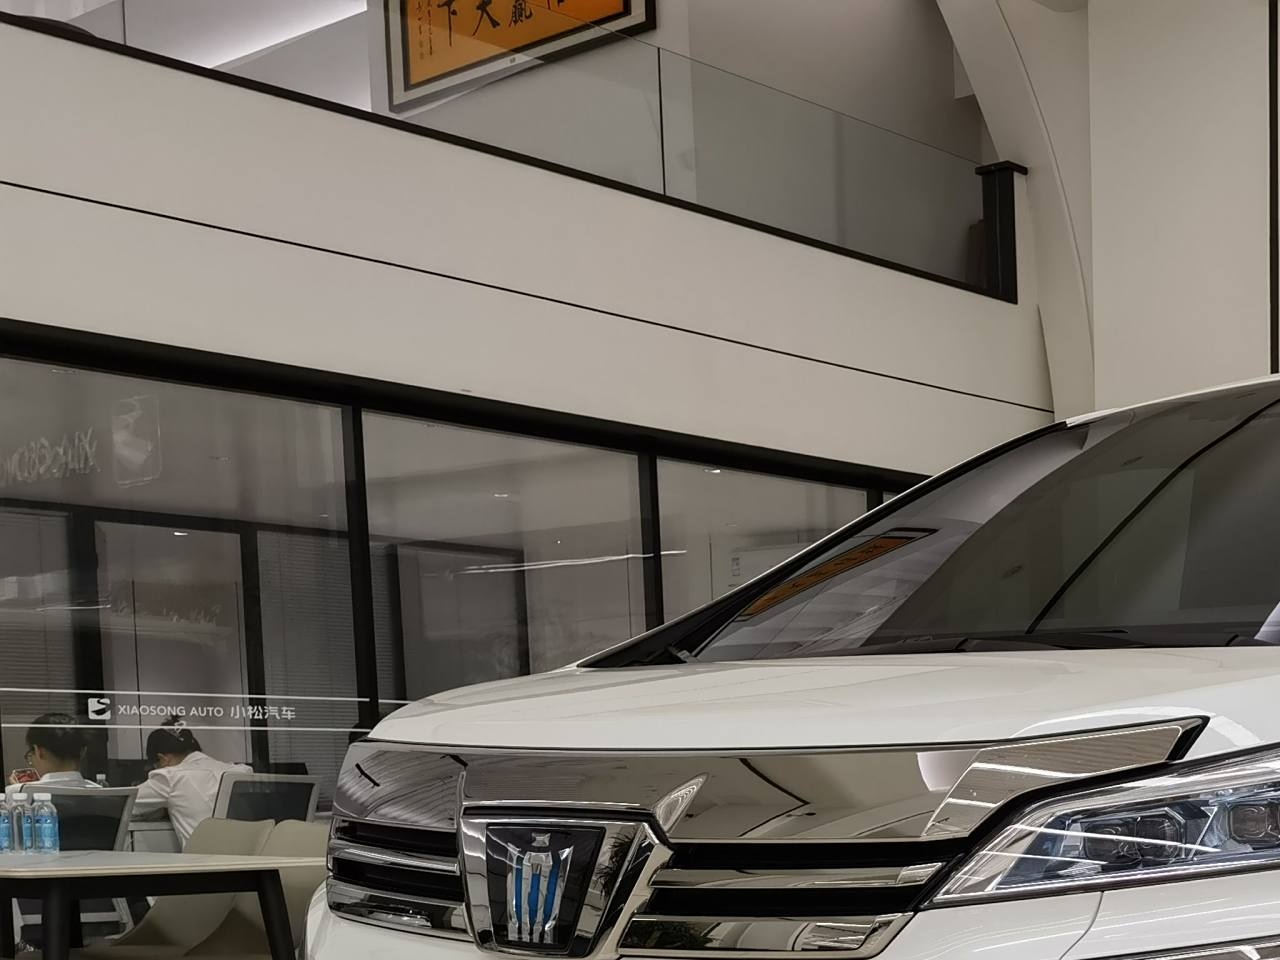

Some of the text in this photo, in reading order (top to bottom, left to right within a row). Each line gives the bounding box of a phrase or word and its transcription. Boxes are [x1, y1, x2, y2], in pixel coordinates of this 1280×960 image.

[118, 704, 224, 718] XIAOSONG AUTO
[230, 705, 296, 720] 小松汽车
